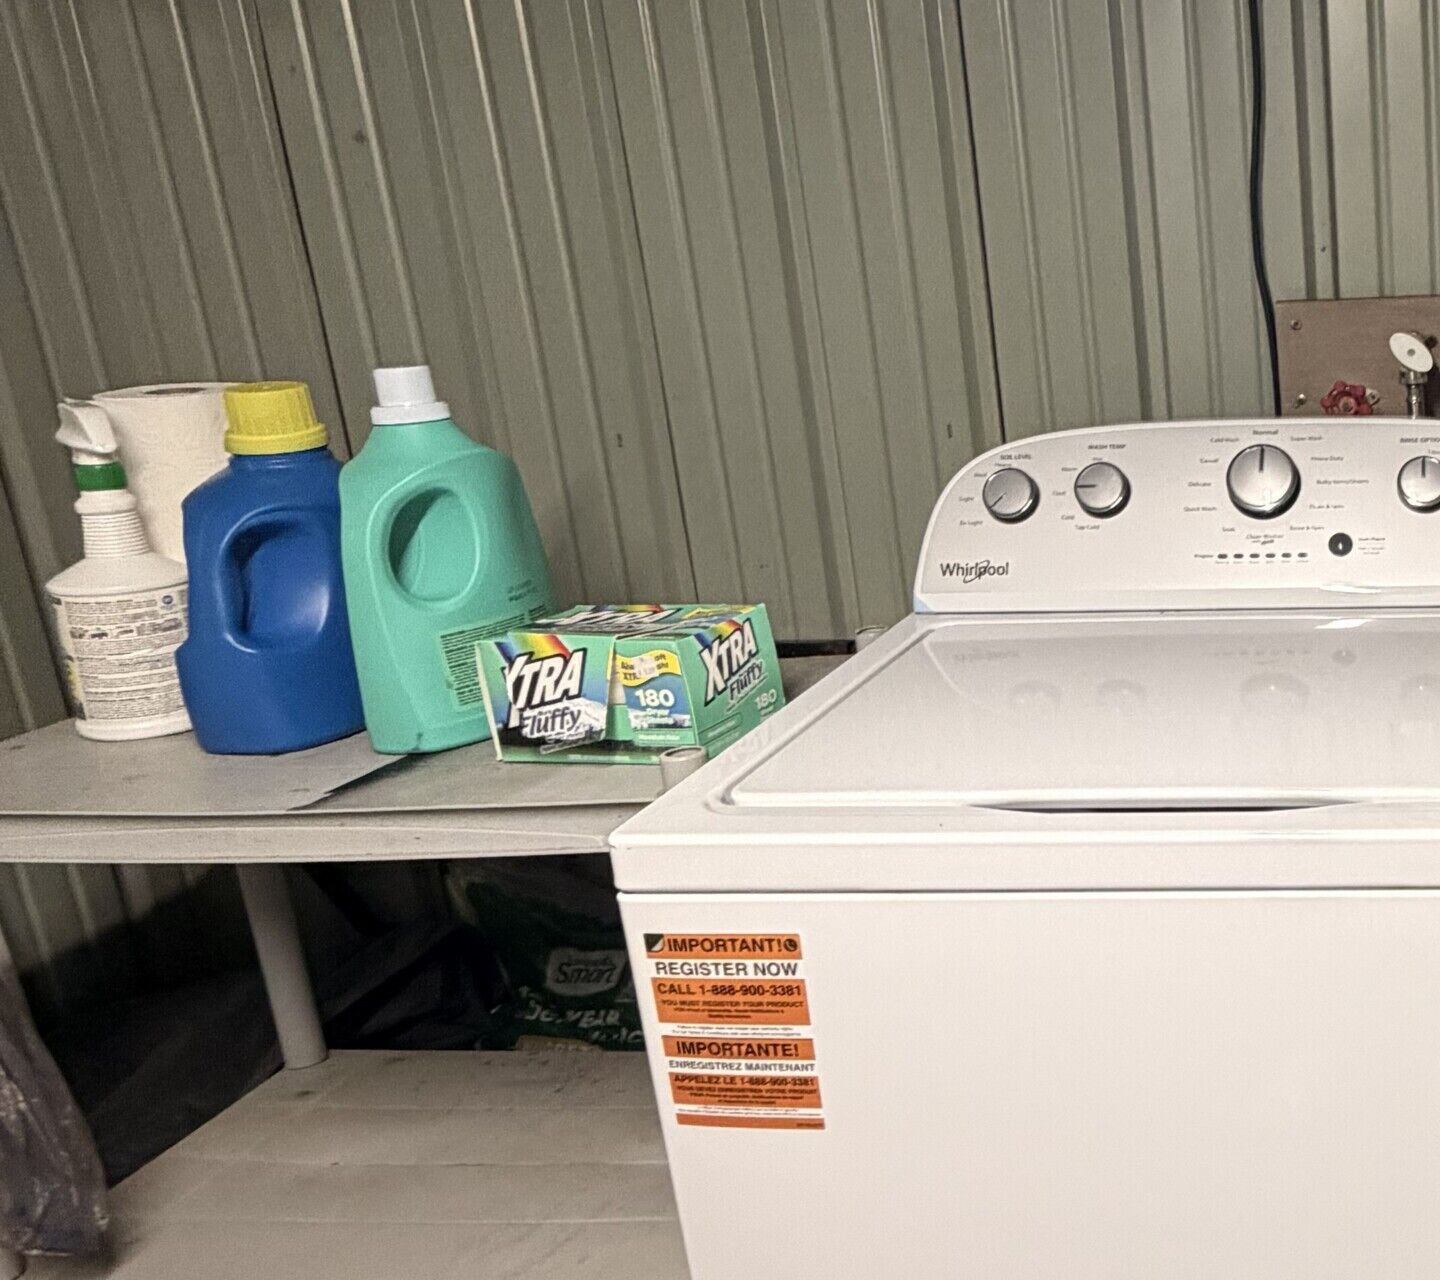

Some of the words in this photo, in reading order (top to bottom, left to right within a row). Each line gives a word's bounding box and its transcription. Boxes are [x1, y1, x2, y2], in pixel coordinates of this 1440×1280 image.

[939, 560, 1009, 581] Whirlpool
[699, 618, 759, 707] XTRA
[501, 648, 587, 730] XTRA
[729, 662, 763, 701] Fluffy
[634, 688, 676, 708] 180
[755, 688, 778, 711] 180
[667, 937, 782, 953] IMPORTANT!
[655, 961, 749, 976] REGISTER
[753, 962, 798, 976] NOW
[657, 983, 696, 995] CALL
[698, 984, 801, 996] 1-888-900-3381
[766, 1000, 804, 1008] PRODUCT
[676, 1040, 799, 1057] IMPORTANTE!
[668, 1059, 742, 1071] ENREGISTREZ
[744, 1062, 815, 1072] MAINTENANT
[674, 1074, 720, 1084] APPELEZ
[723, 1076, 737, 1085] LE
